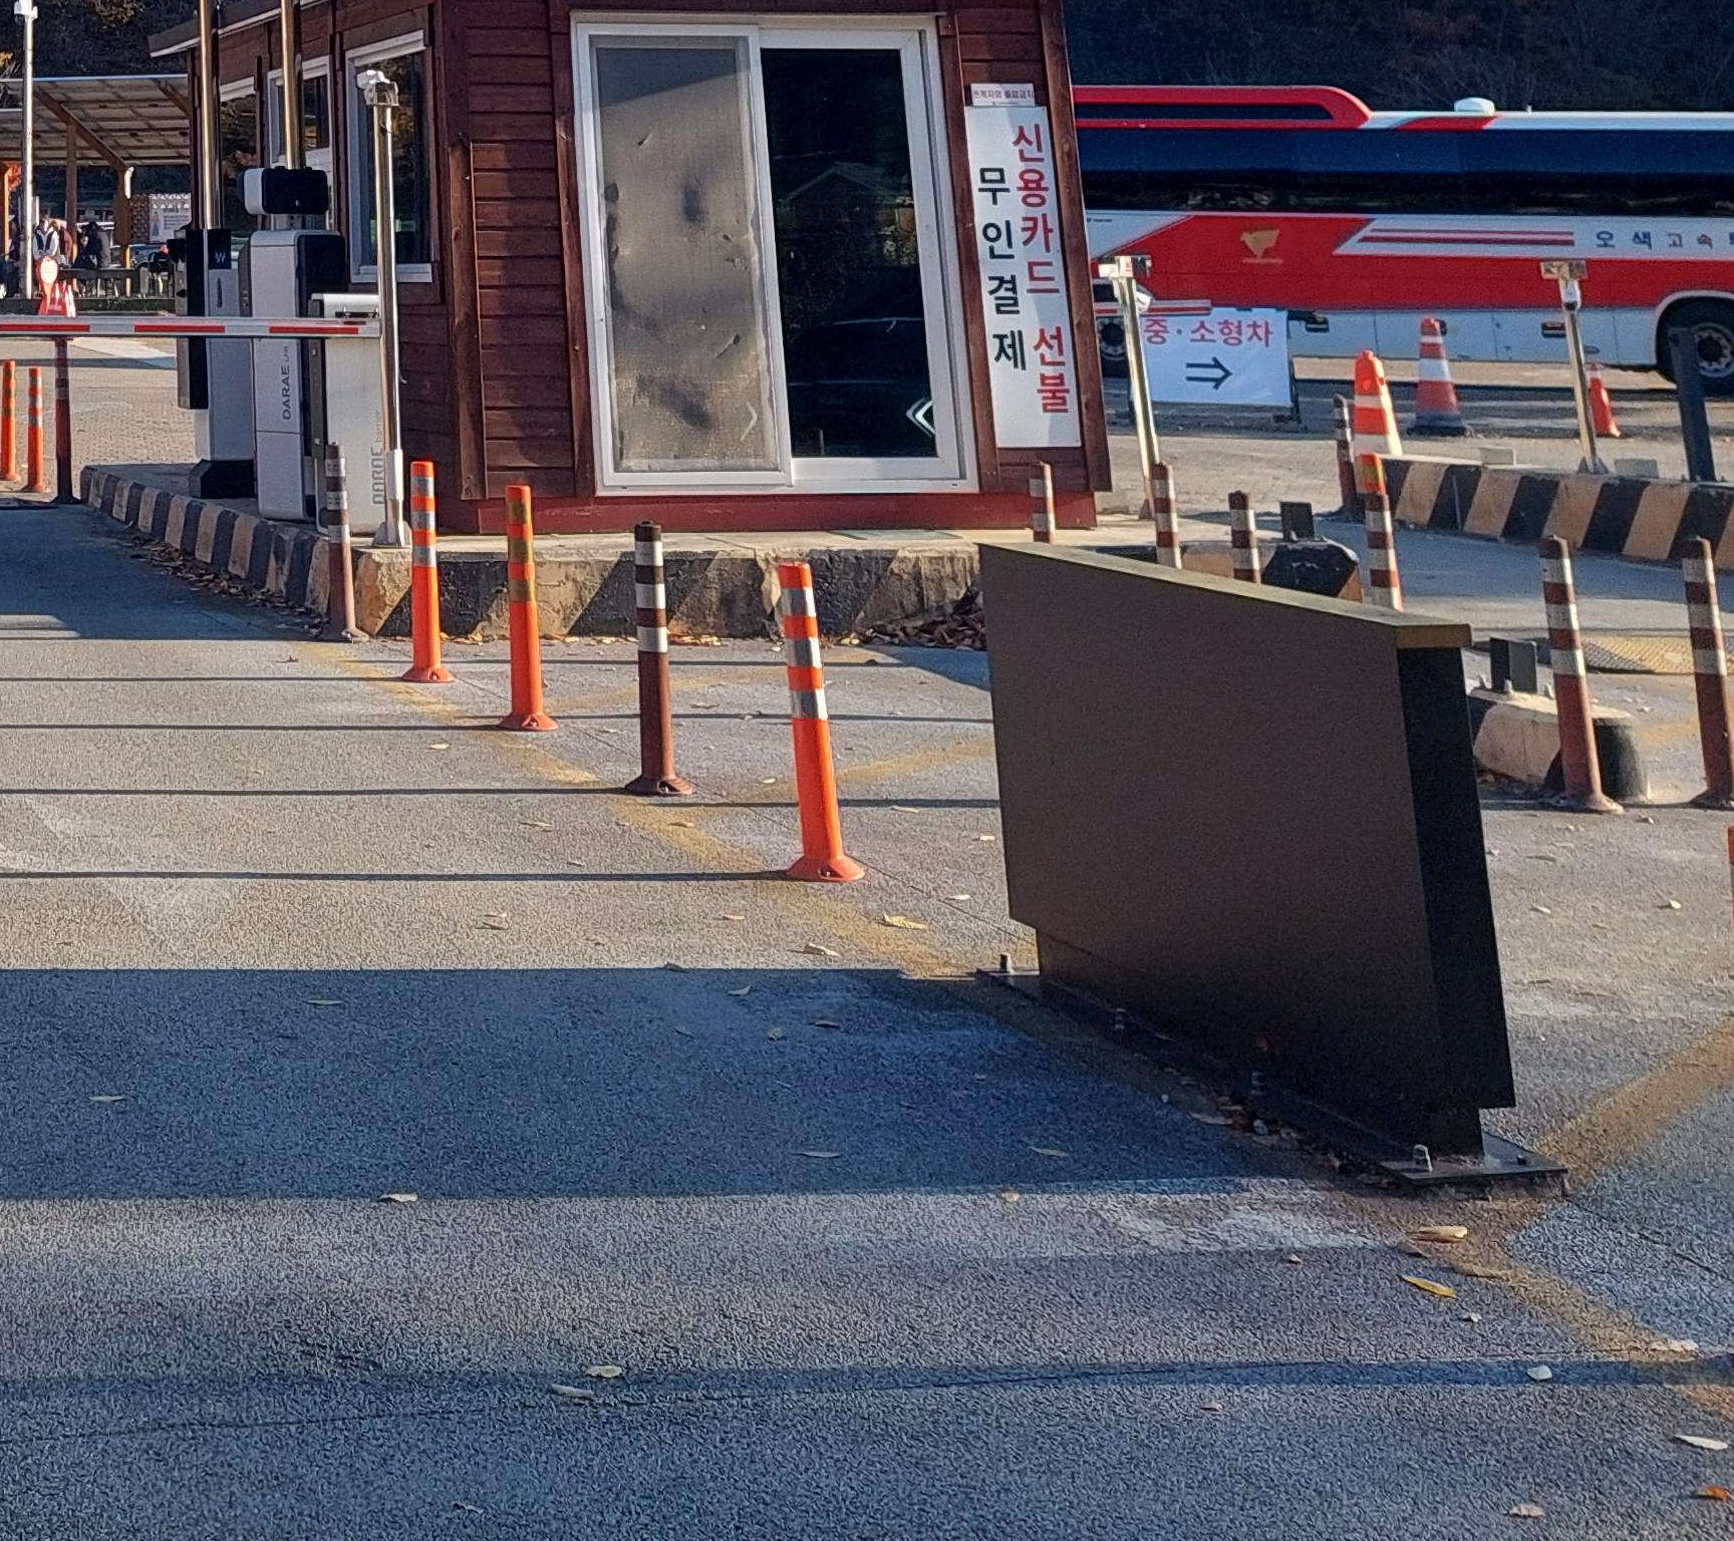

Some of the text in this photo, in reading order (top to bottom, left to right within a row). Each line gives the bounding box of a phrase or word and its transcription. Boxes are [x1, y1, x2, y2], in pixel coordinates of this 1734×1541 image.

[977, 167, 1027, 371] 무인결제
[1012, 123, 1071, 414] 신용카드 선불
[1143, 318, 1274, 348] 중·소형차
[282, 364, 291, 421] DARAE
